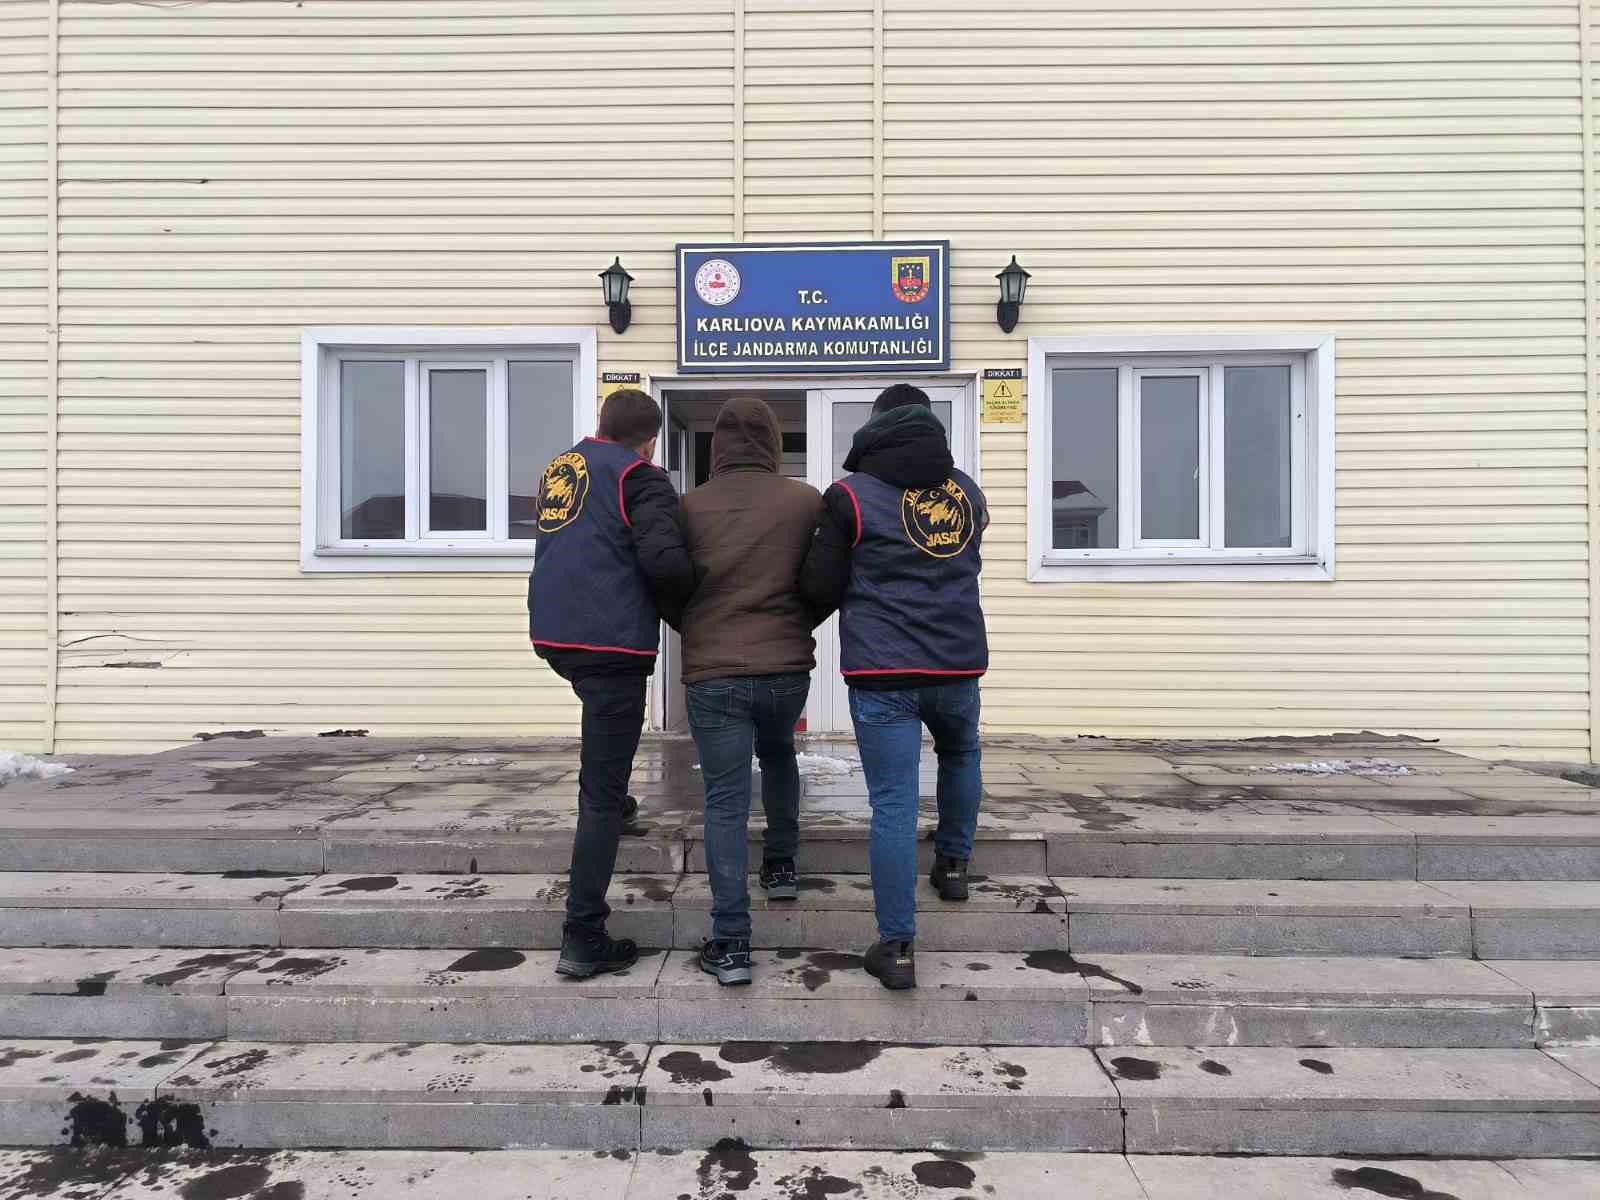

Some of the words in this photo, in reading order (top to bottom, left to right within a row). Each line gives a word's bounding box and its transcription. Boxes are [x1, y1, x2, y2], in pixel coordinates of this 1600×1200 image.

[798, 290, 828, 304] T.C.
[696, 317, 786, 332] KARLIOVA
[791, 313, 930, 331] KAYMAKAMLIĞI
[693, 339, 728, 357] İLÇE
[733, 340, 819, 356] JANDARMA
[823, 337, 933, 355] KOMUTANLIĞI
[926, 531, 961, 547] JASAT
